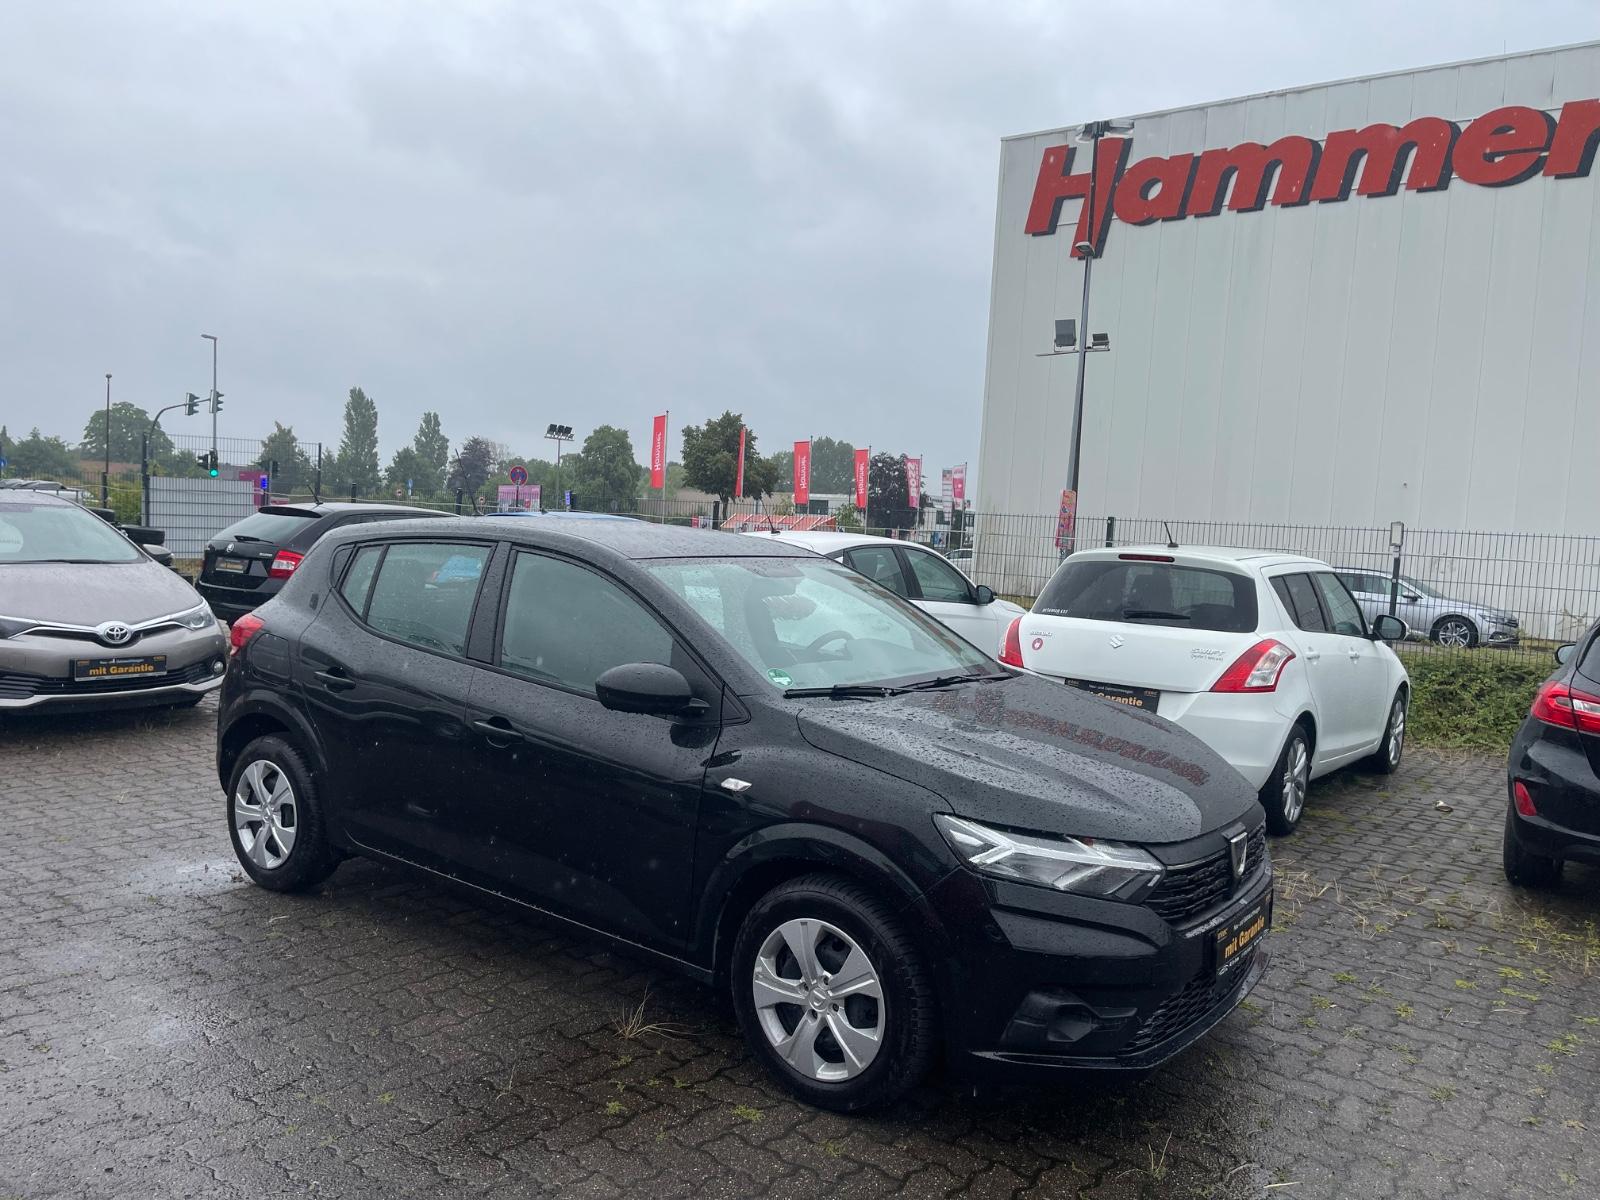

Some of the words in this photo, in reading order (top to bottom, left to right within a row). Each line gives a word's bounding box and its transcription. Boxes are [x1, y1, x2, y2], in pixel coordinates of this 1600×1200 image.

[1024, 98, 1600, 260] Hammer
[89, 667, 107, 676] mit
[110, 663, 154, 674] Garantie
[1224, 936, 1238, 958] mit
[1239, 915, 1265, 948] Garantie
